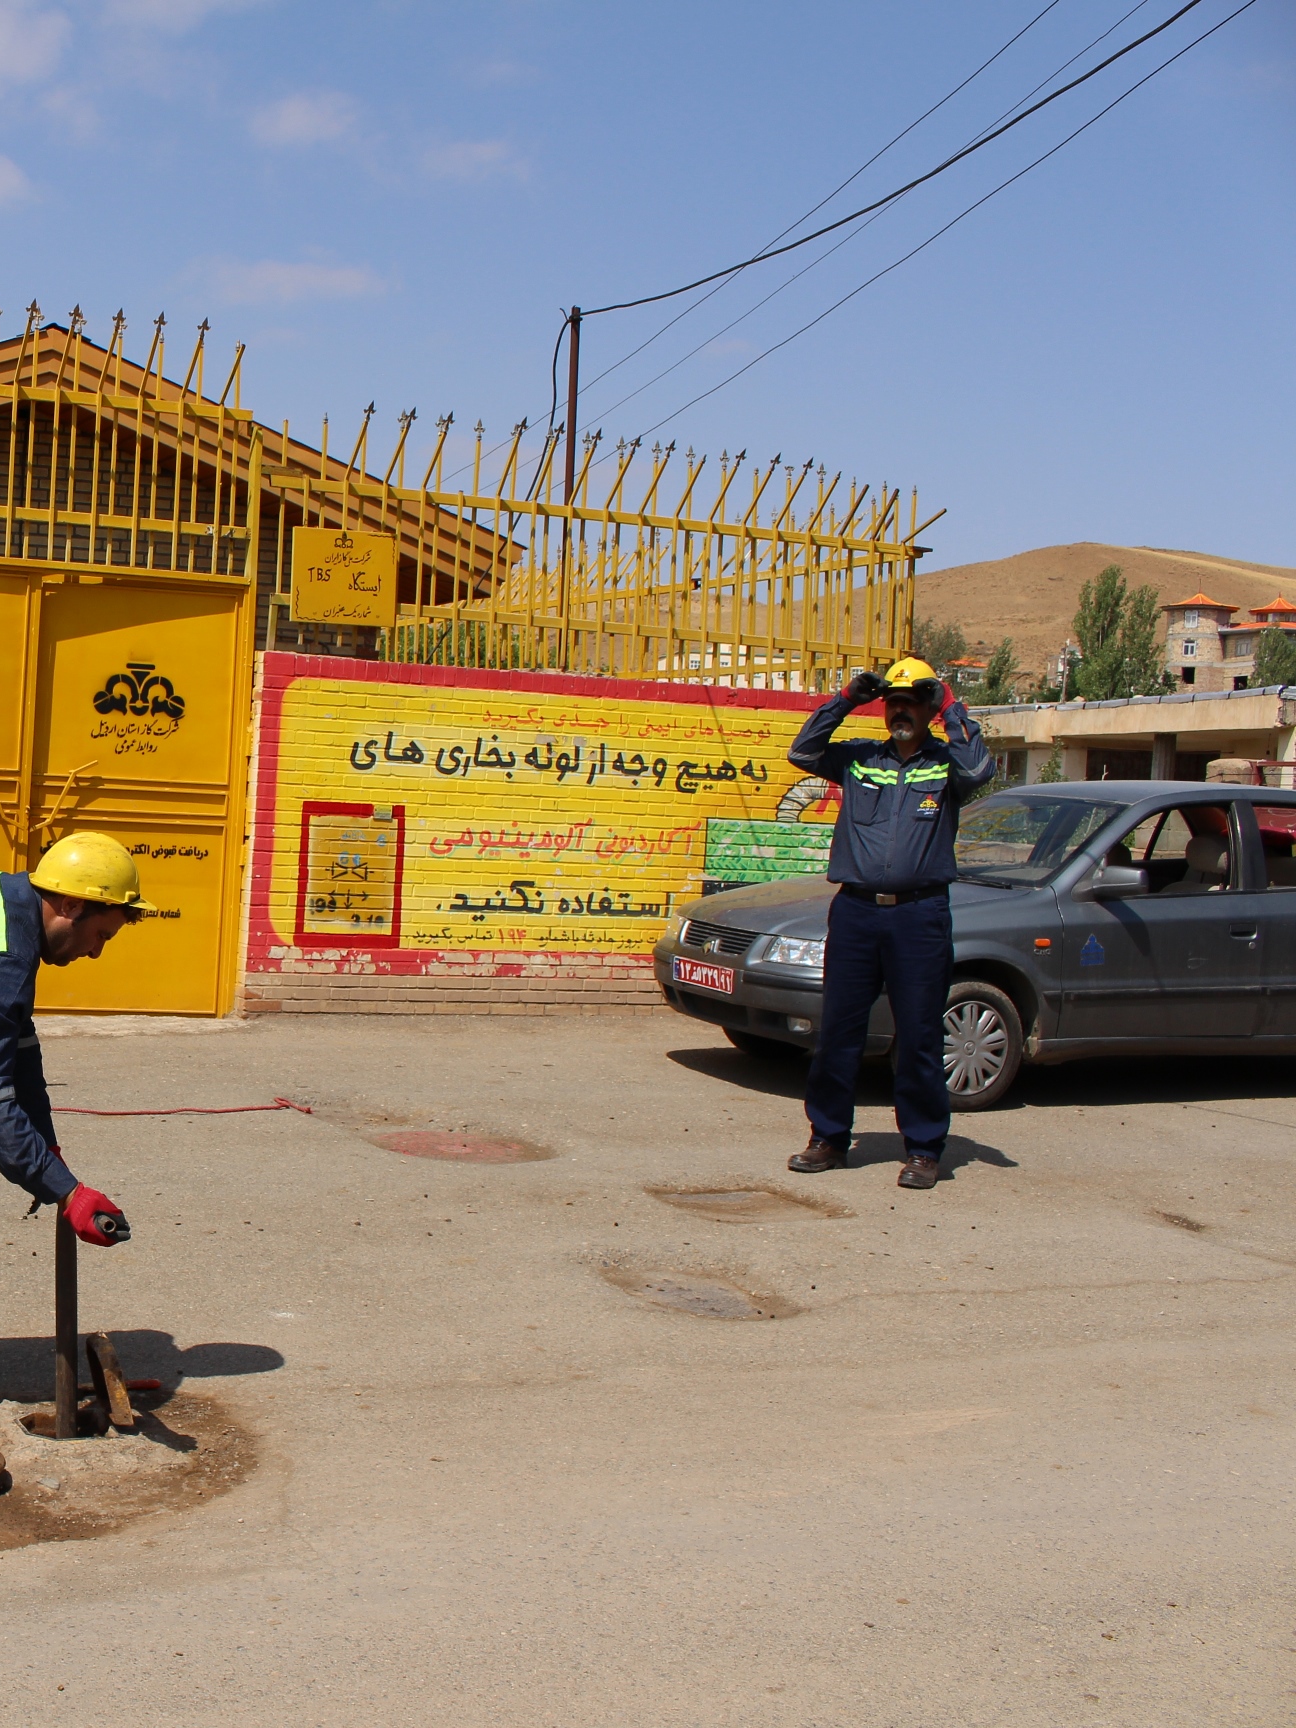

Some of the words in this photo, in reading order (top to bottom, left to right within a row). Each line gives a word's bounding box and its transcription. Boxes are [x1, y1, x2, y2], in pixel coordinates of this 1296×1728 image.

[347, 571, 382, 597] ایستگاه
[90, 719, 117, 739] اردبیل
[116, 723, 140, 738] استان
[618, 712, 631, 736] را
[637, 717, 677, 740] ایمنی
[114, 739, 137, 755] عمومی
[349, 730, 425, 771] های
[435, 733, 517, 780] بخاری
[611, 752, 668, 788] وجه
[675, 759, 738, 795] هیچ
[740, 758, 769, 793] به
[151, 844, 177, 860] قبوض
[177, 845, 209, 861] دریافت
[557, 885, 673, 919] استفاده
[456, 927, 495, 944] تماس
